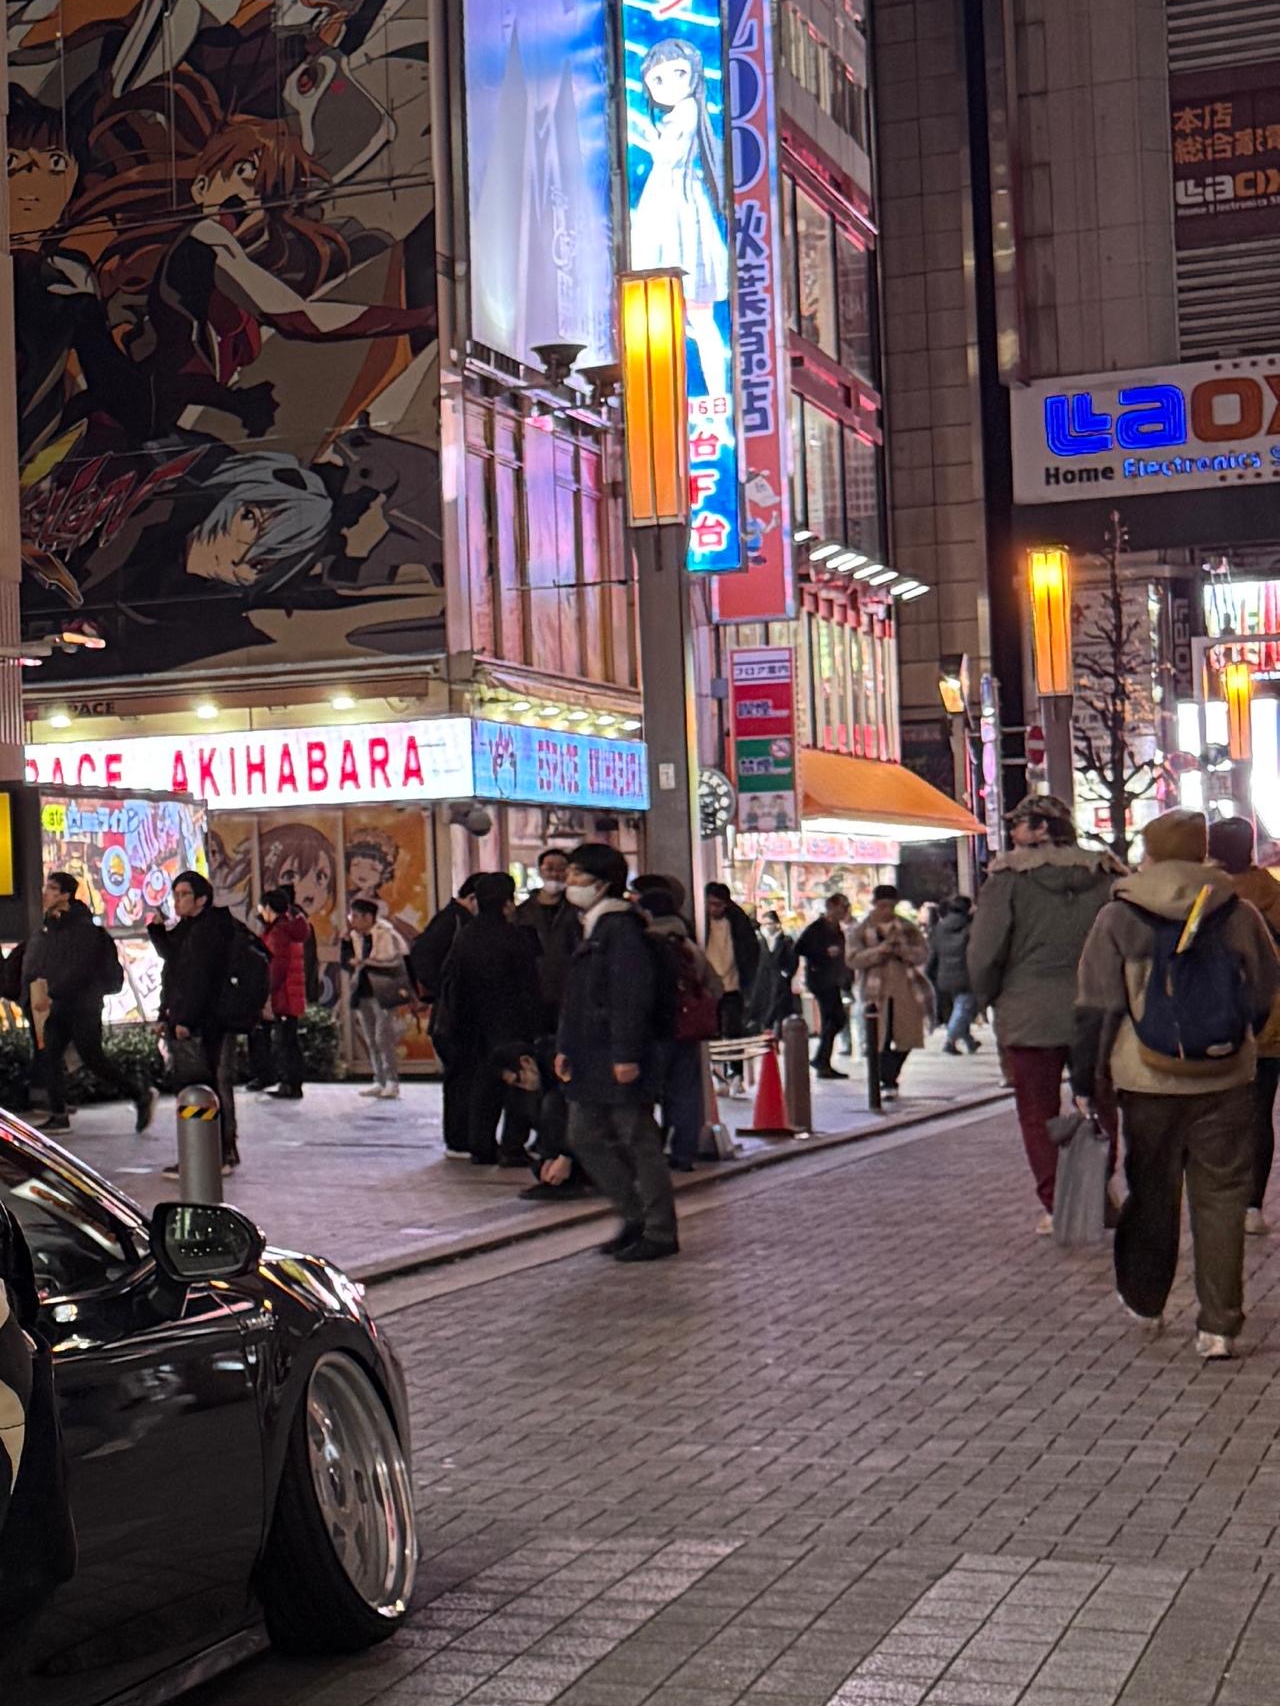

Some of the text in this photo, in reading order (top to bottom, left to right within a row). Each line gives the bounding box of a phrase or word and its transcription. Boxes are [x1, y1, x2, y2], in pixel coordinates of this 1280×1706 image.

[1173, 101, 1233, 133] 本店
[1044, 465, 1116, 487] Home
[1122, 448, 1263, 479] Electronics
[169, 734, 427, 797] AKIHABARA
